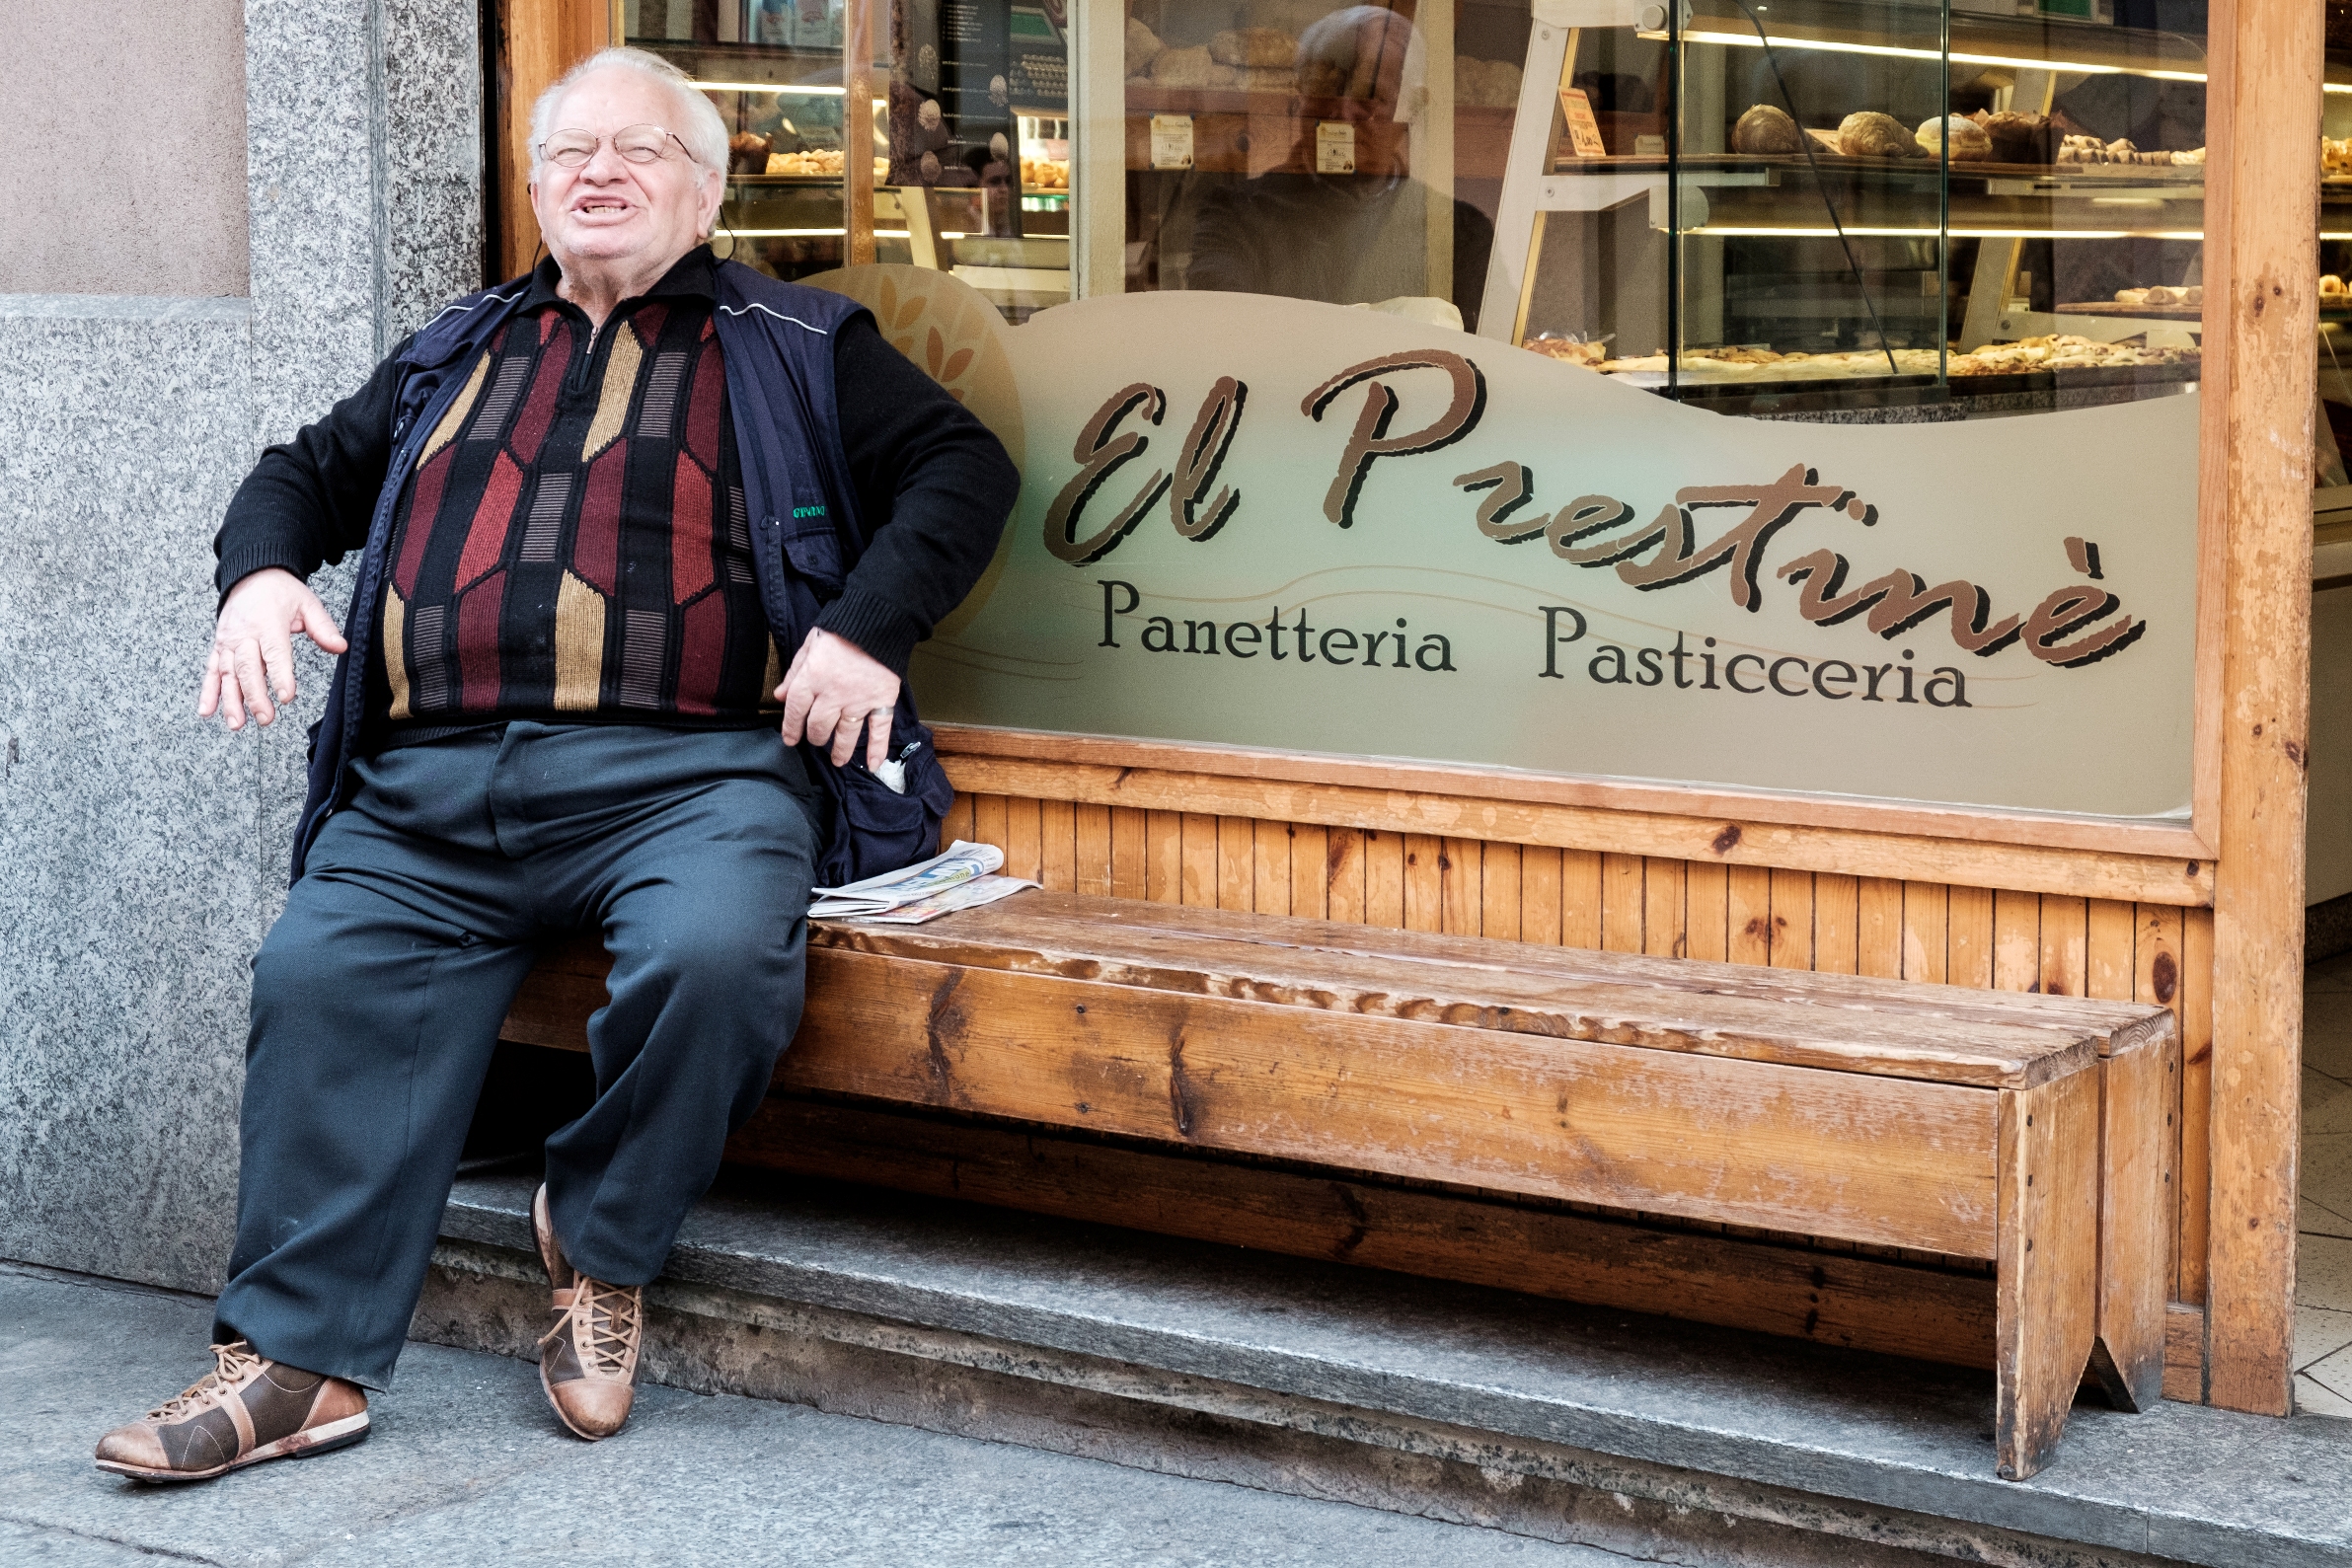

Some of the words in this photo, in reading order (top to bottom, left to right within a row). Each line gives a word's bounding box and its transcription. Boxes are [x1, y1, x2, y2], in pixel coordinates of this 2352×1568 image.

[1043, 375, 1248, 567] El
[1300, 348, 2146, 669] Prestinè
[1097, 579, 1458, 672] Panetteria
[1538, 605, 1973, 709] Pasticceria
